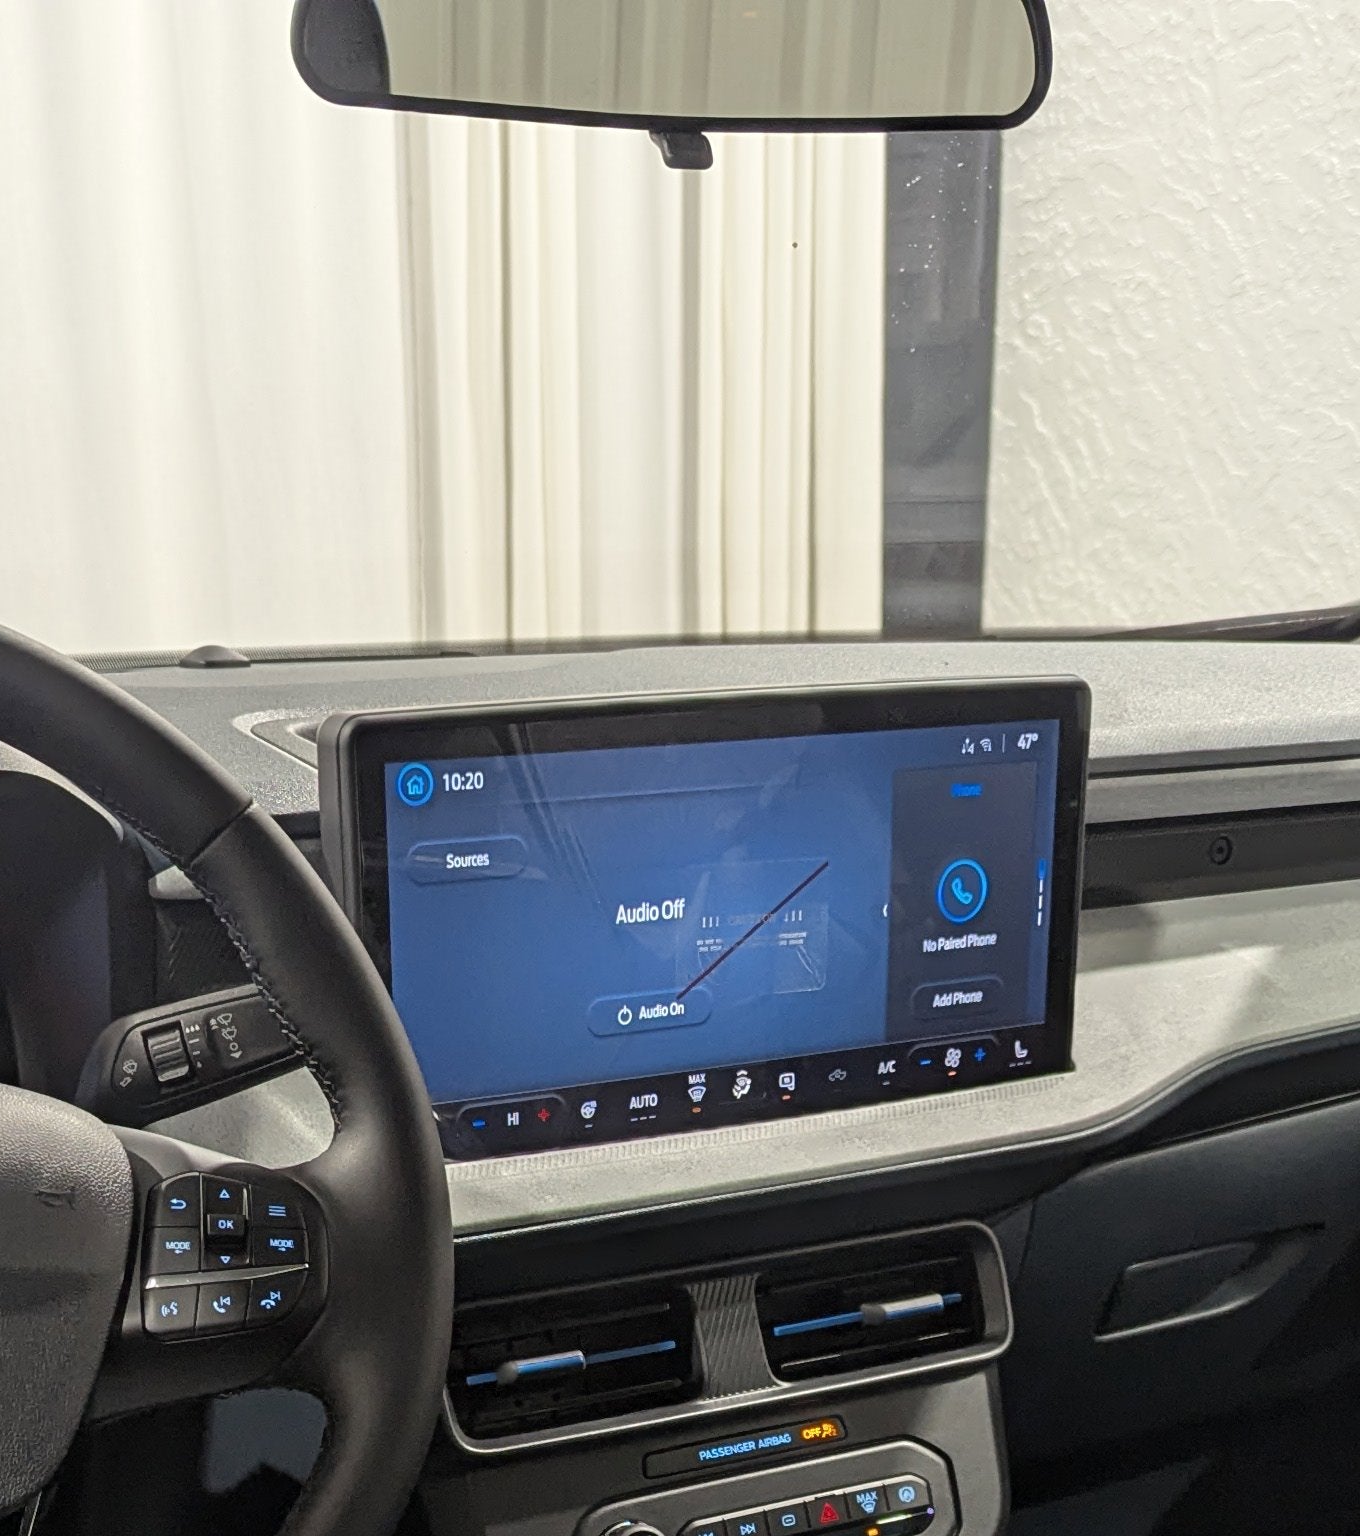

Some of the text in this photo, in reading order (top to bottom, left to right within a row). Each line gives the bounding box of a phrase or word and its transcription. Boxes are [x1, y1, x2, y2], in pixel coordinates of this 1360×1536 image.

[1017, 733, 1039, 750] 47°
[442, 771, 484, 792] 10:20
[446, 853, 490, 869] Sources
[616, 898, 686, 925] Audio Off
[922, 933, 998, 953] No Paired Phone
[932, 990, 983, 1008] Add Phone
[638, 1002, 685, 1020] Audio On
[878, 1060, 896, 1075] A/C
[688, 1073, 706, 1085] MAX
[629, 1094, 659, 1110] AUTO
[217, 1219, 234, 1230] OK
[165, 1241, 191, 1250] MODE
[269, 1238, 295, 1249] MODE
[802, 1427, 822, 1440] OFF
[698, 1433, 792, 1461] PASSENGER AIRBAG
[856, 1490, 878, 1504] MAX
